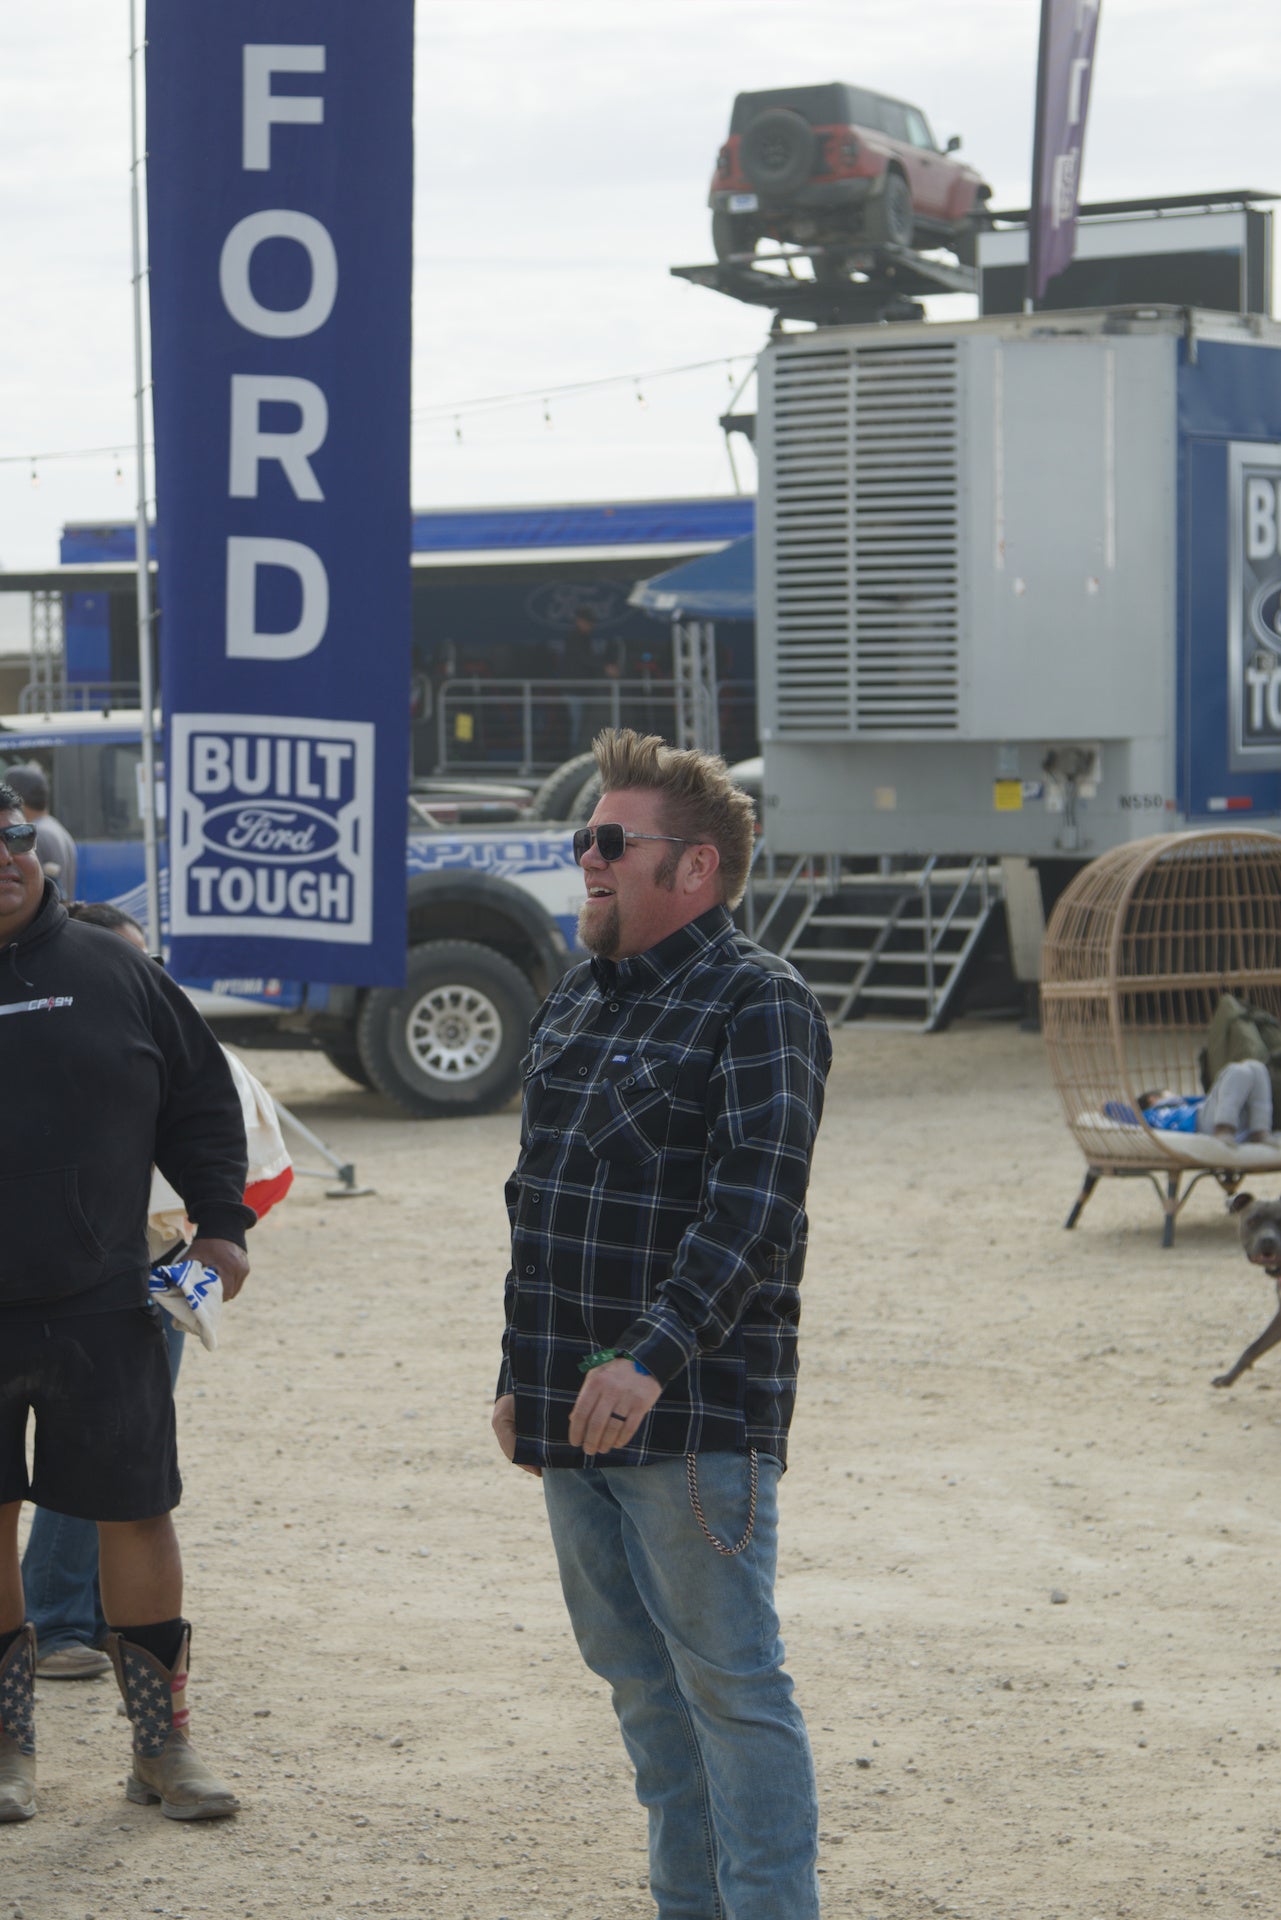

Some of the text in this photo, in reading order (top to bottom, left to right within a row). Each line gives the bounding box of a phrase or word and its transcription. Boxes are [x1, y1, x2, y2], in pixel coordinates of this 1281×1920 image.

[218, 43, 340, 661] FORD
[193, 736, 352, 801] BUILT
[226, 809, 317, 853] Ford
[190, 866, 350, 920] TOUGH
